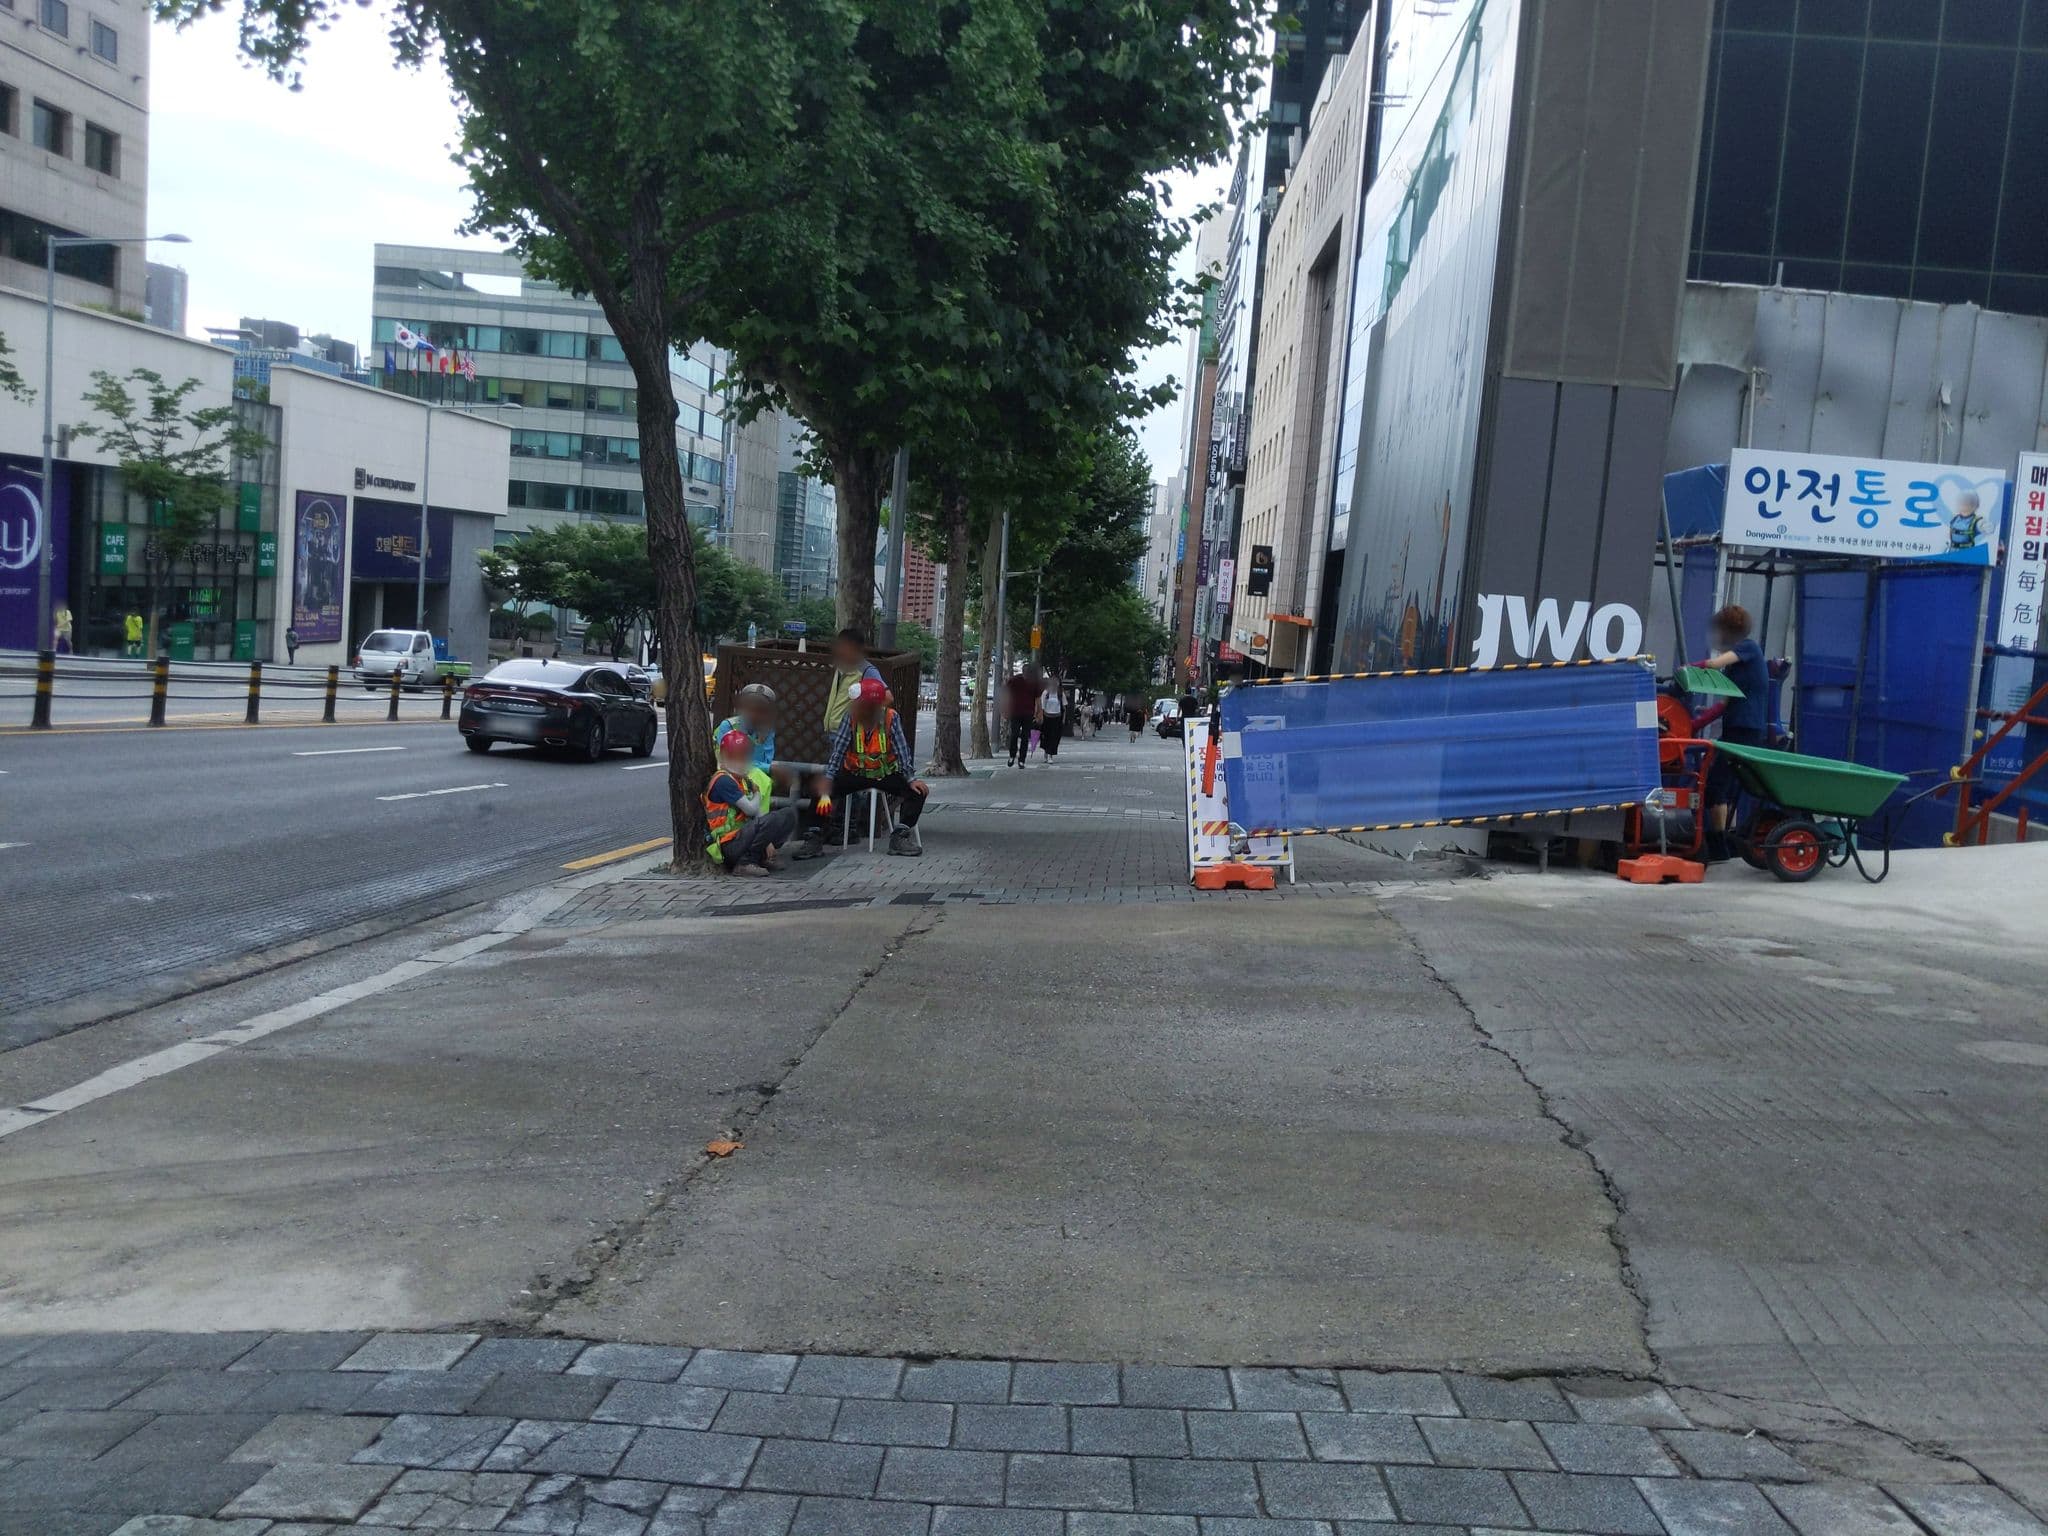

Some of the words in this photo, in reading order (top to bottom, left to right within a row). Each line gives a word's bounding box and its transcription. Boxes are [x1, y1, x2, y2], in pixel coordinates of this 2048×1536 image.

[1744, 466, 1942, 529] 안전통로
[2025, 516, 2048, 537] 집
[106, 535, 125, 545] CAFE
[1745, 529, 1782, 541] Dongwon
[261, 542, 275, 552] CAFE
